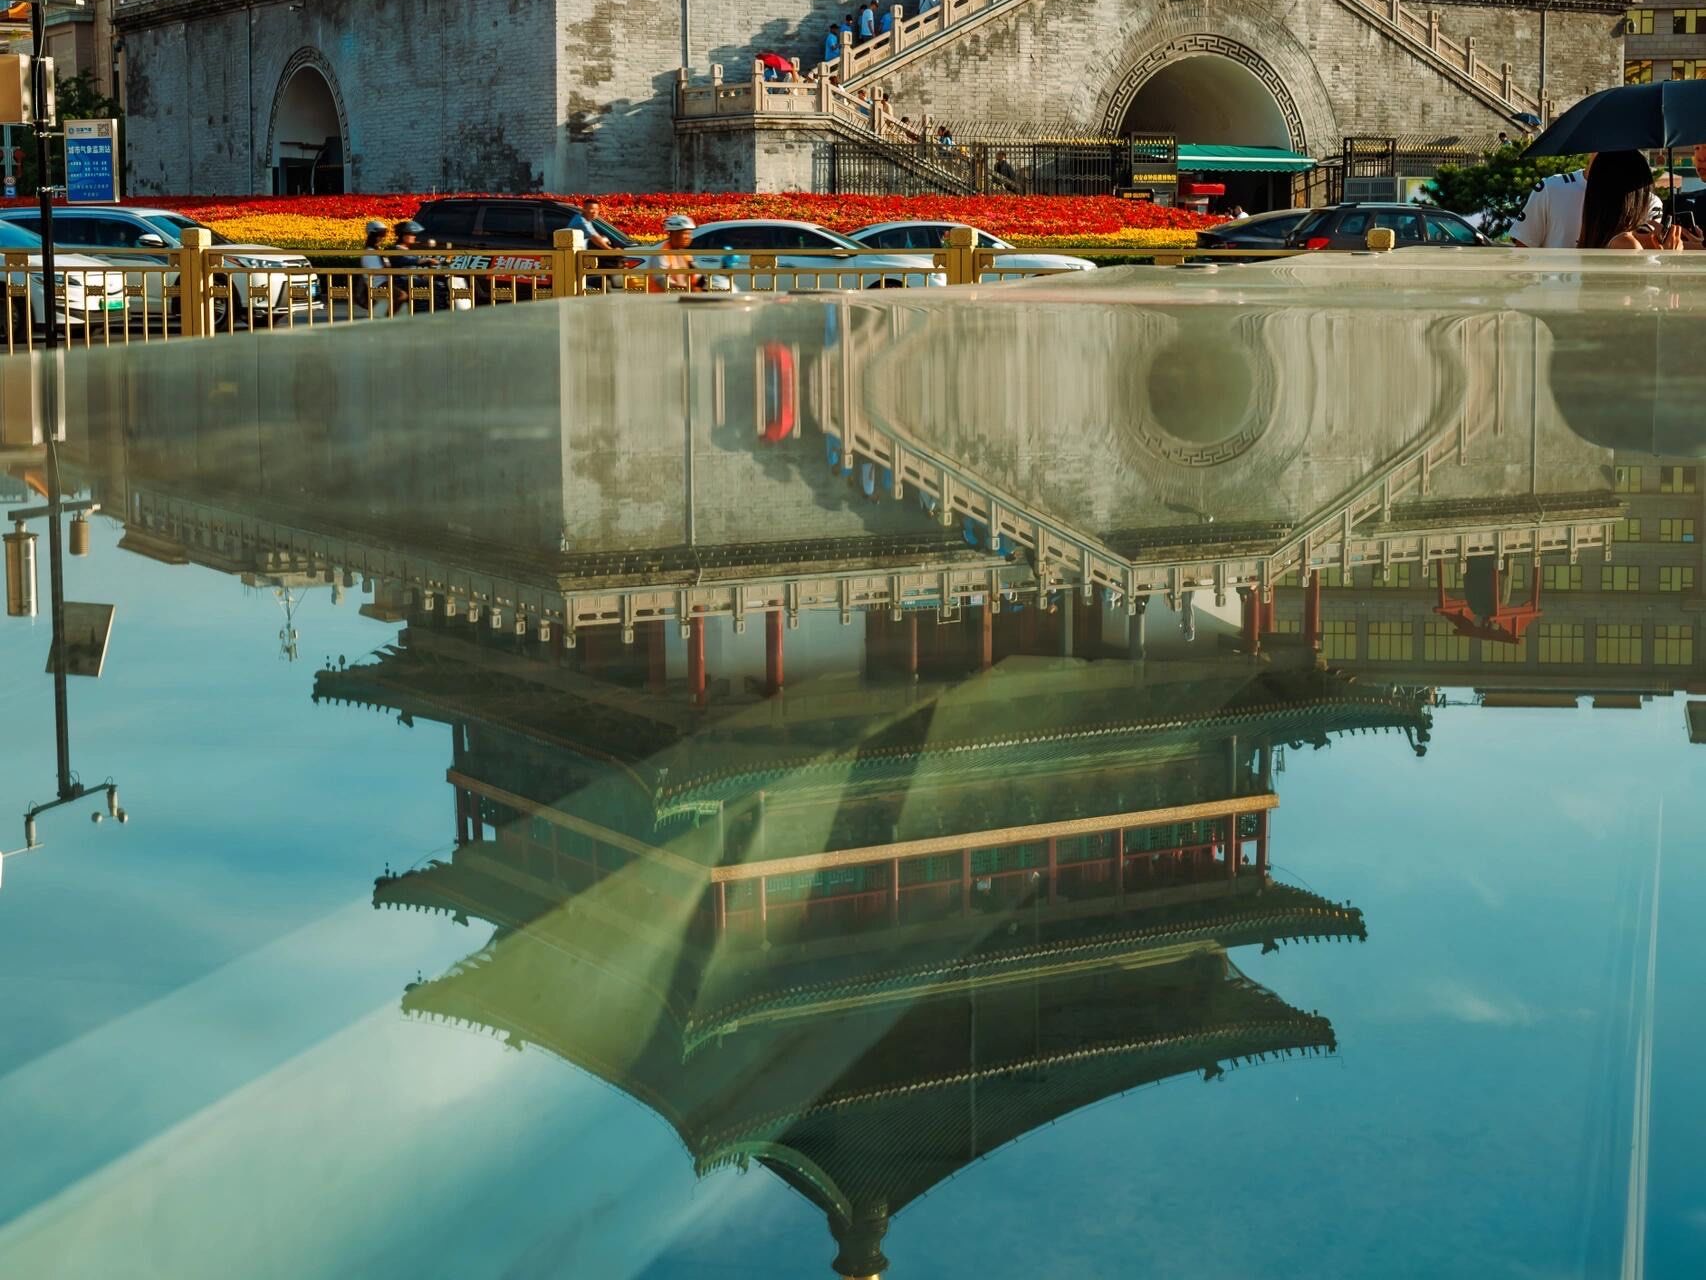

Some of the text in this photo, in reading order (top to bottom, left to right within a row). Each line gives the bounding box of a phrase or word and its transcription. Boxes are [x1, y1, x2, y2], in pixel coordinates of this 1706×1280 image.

[68, 145, 110, 154] 城市气象监测站
